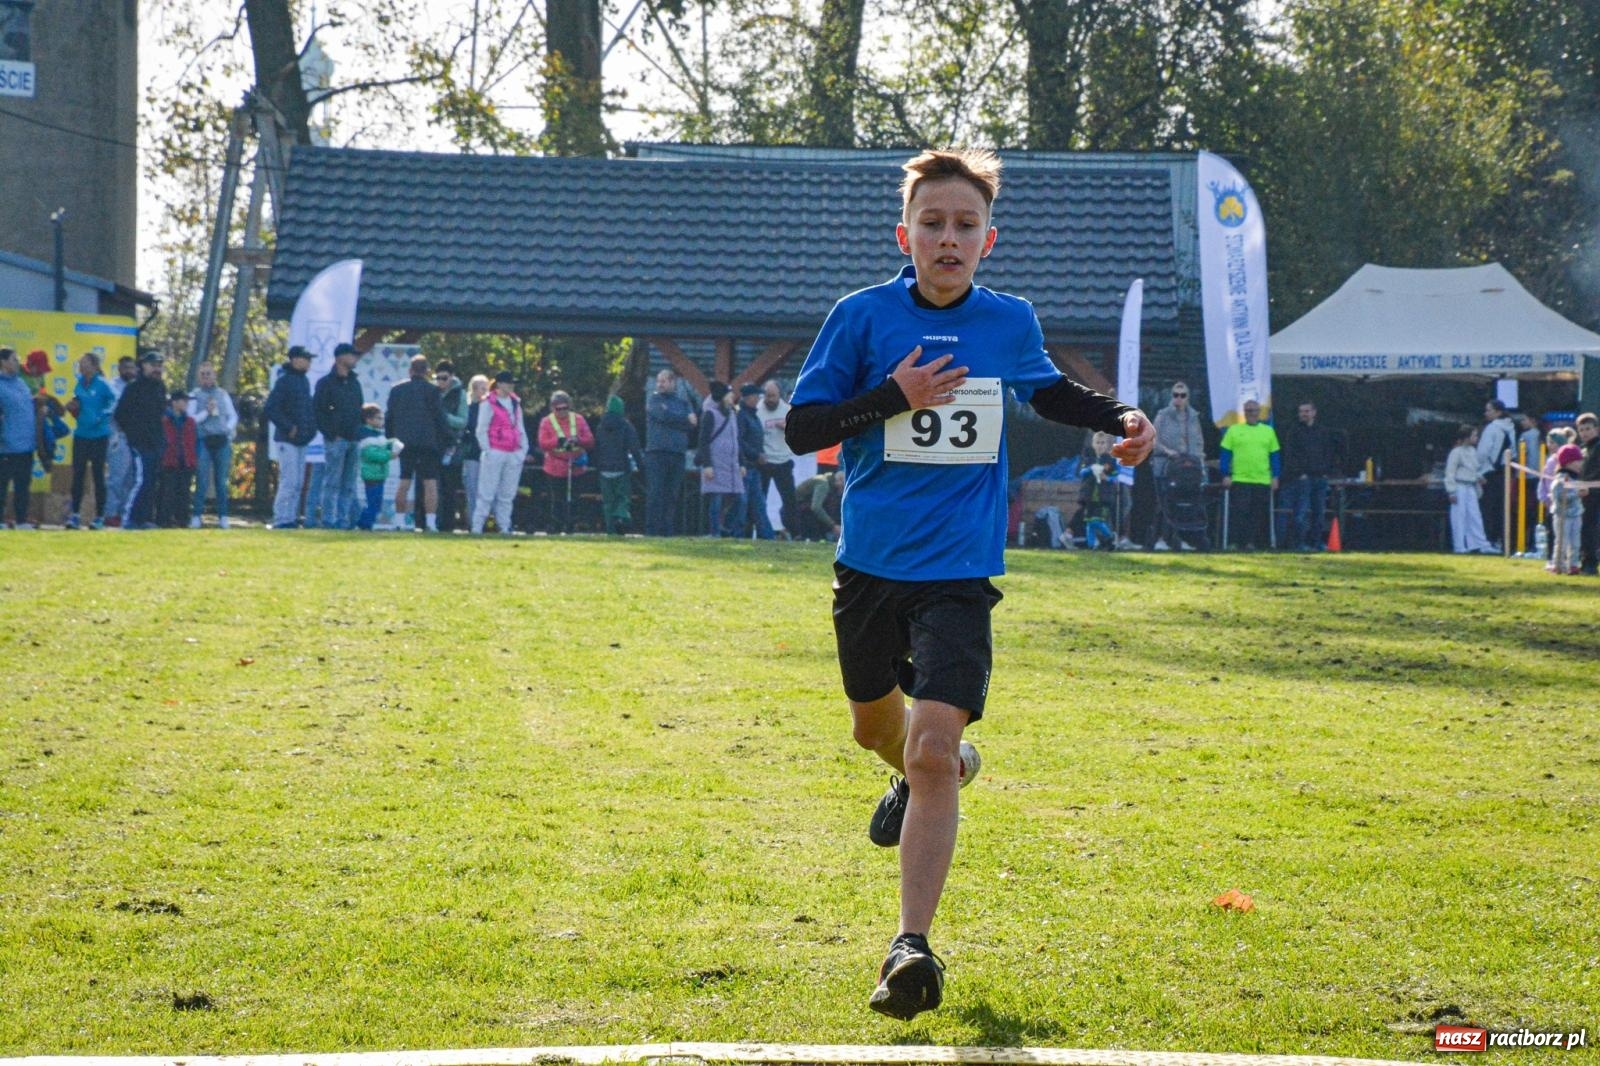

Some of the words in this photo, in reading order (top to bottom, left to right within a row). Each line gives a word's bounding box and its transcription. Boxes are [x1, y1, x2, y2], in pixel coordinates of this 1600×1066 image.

[1300, 354, 1388, 370] STOWARZYSZENIE
[1398, 354, 1442, 369] AKTYWNI
[1452, 354, 1471, 368] DLA
[1481, 354, 1533, 368] LEPSZEGO
[1543, 353, 1576, 367] JUTRA
[839, 411, 883, 429] KIPSTA
[911, 409, 978, 449] 93
